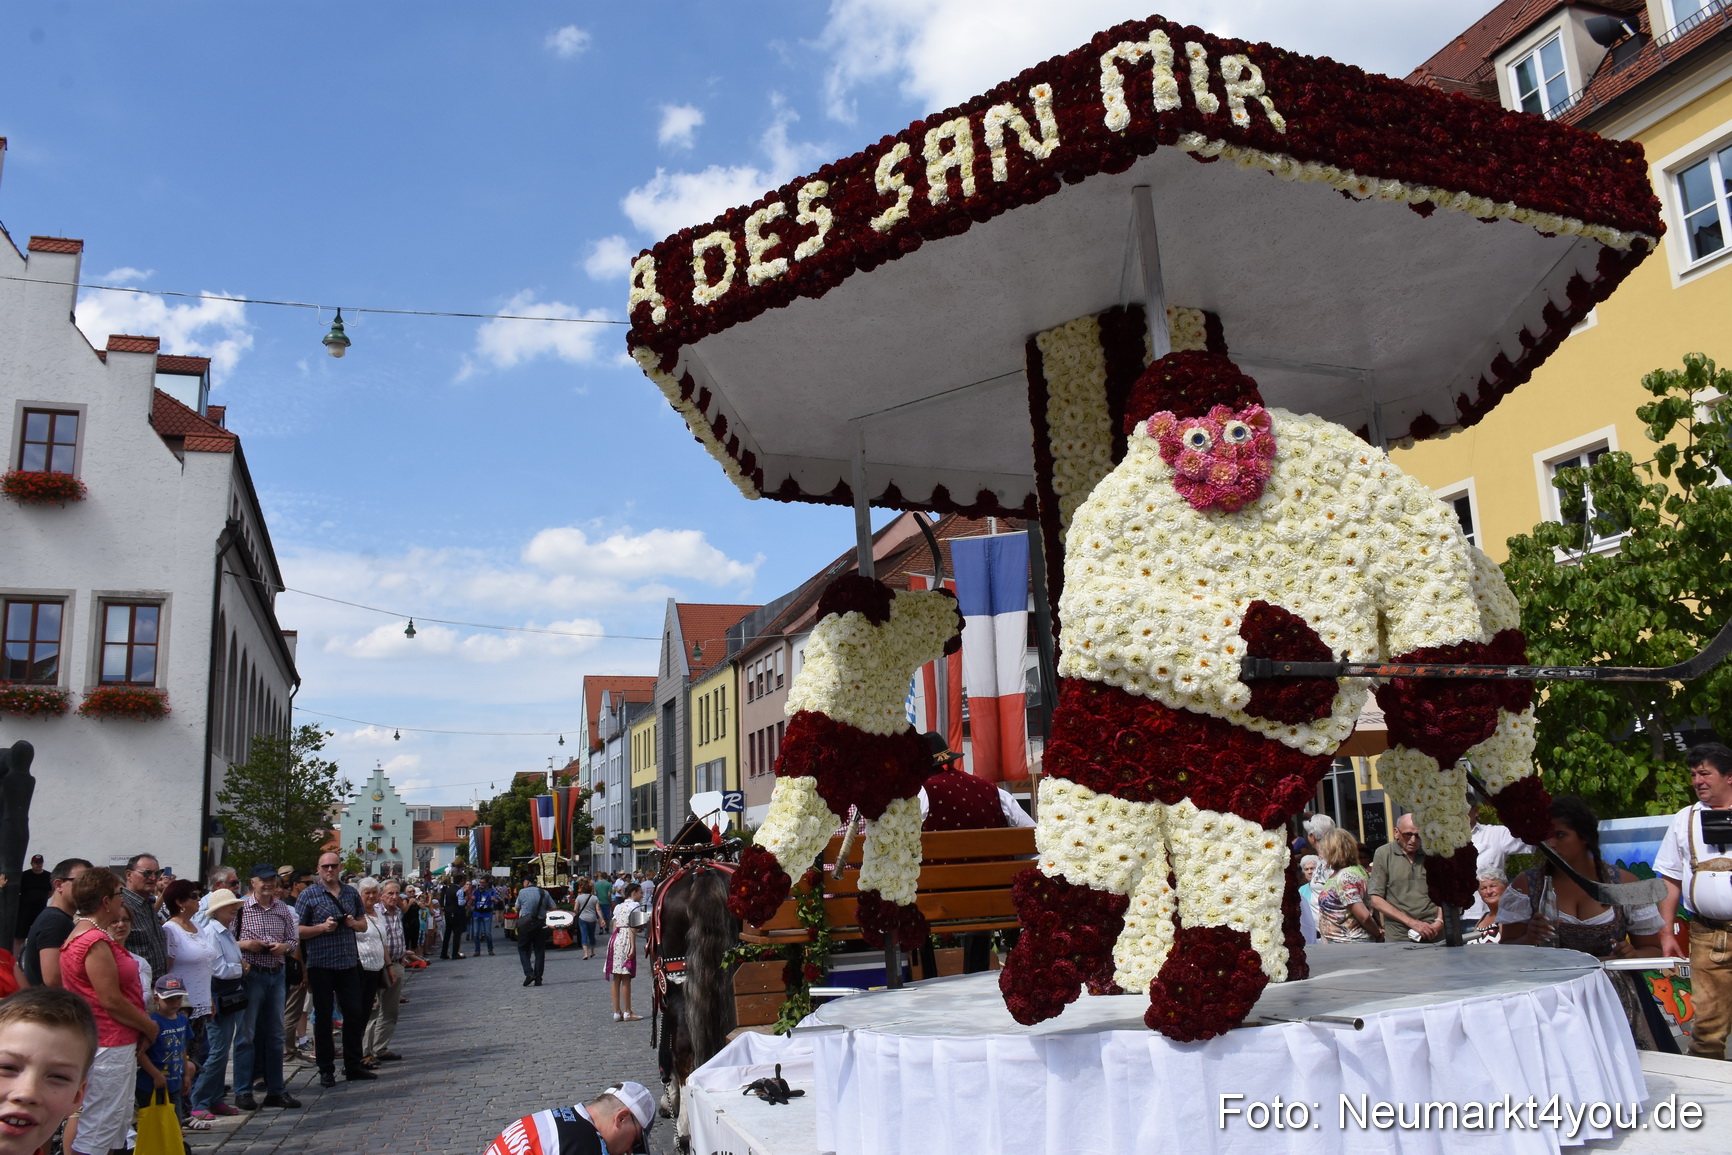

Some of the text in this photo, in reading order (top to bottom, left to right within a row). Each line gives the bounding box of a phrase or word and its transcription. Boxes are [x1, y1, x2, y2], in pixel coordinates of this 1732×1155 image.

[692, 180, 834, 307] DES
[870, 82, 1061, 234] SAN
[1099, 28, 1287, 134] MIR
